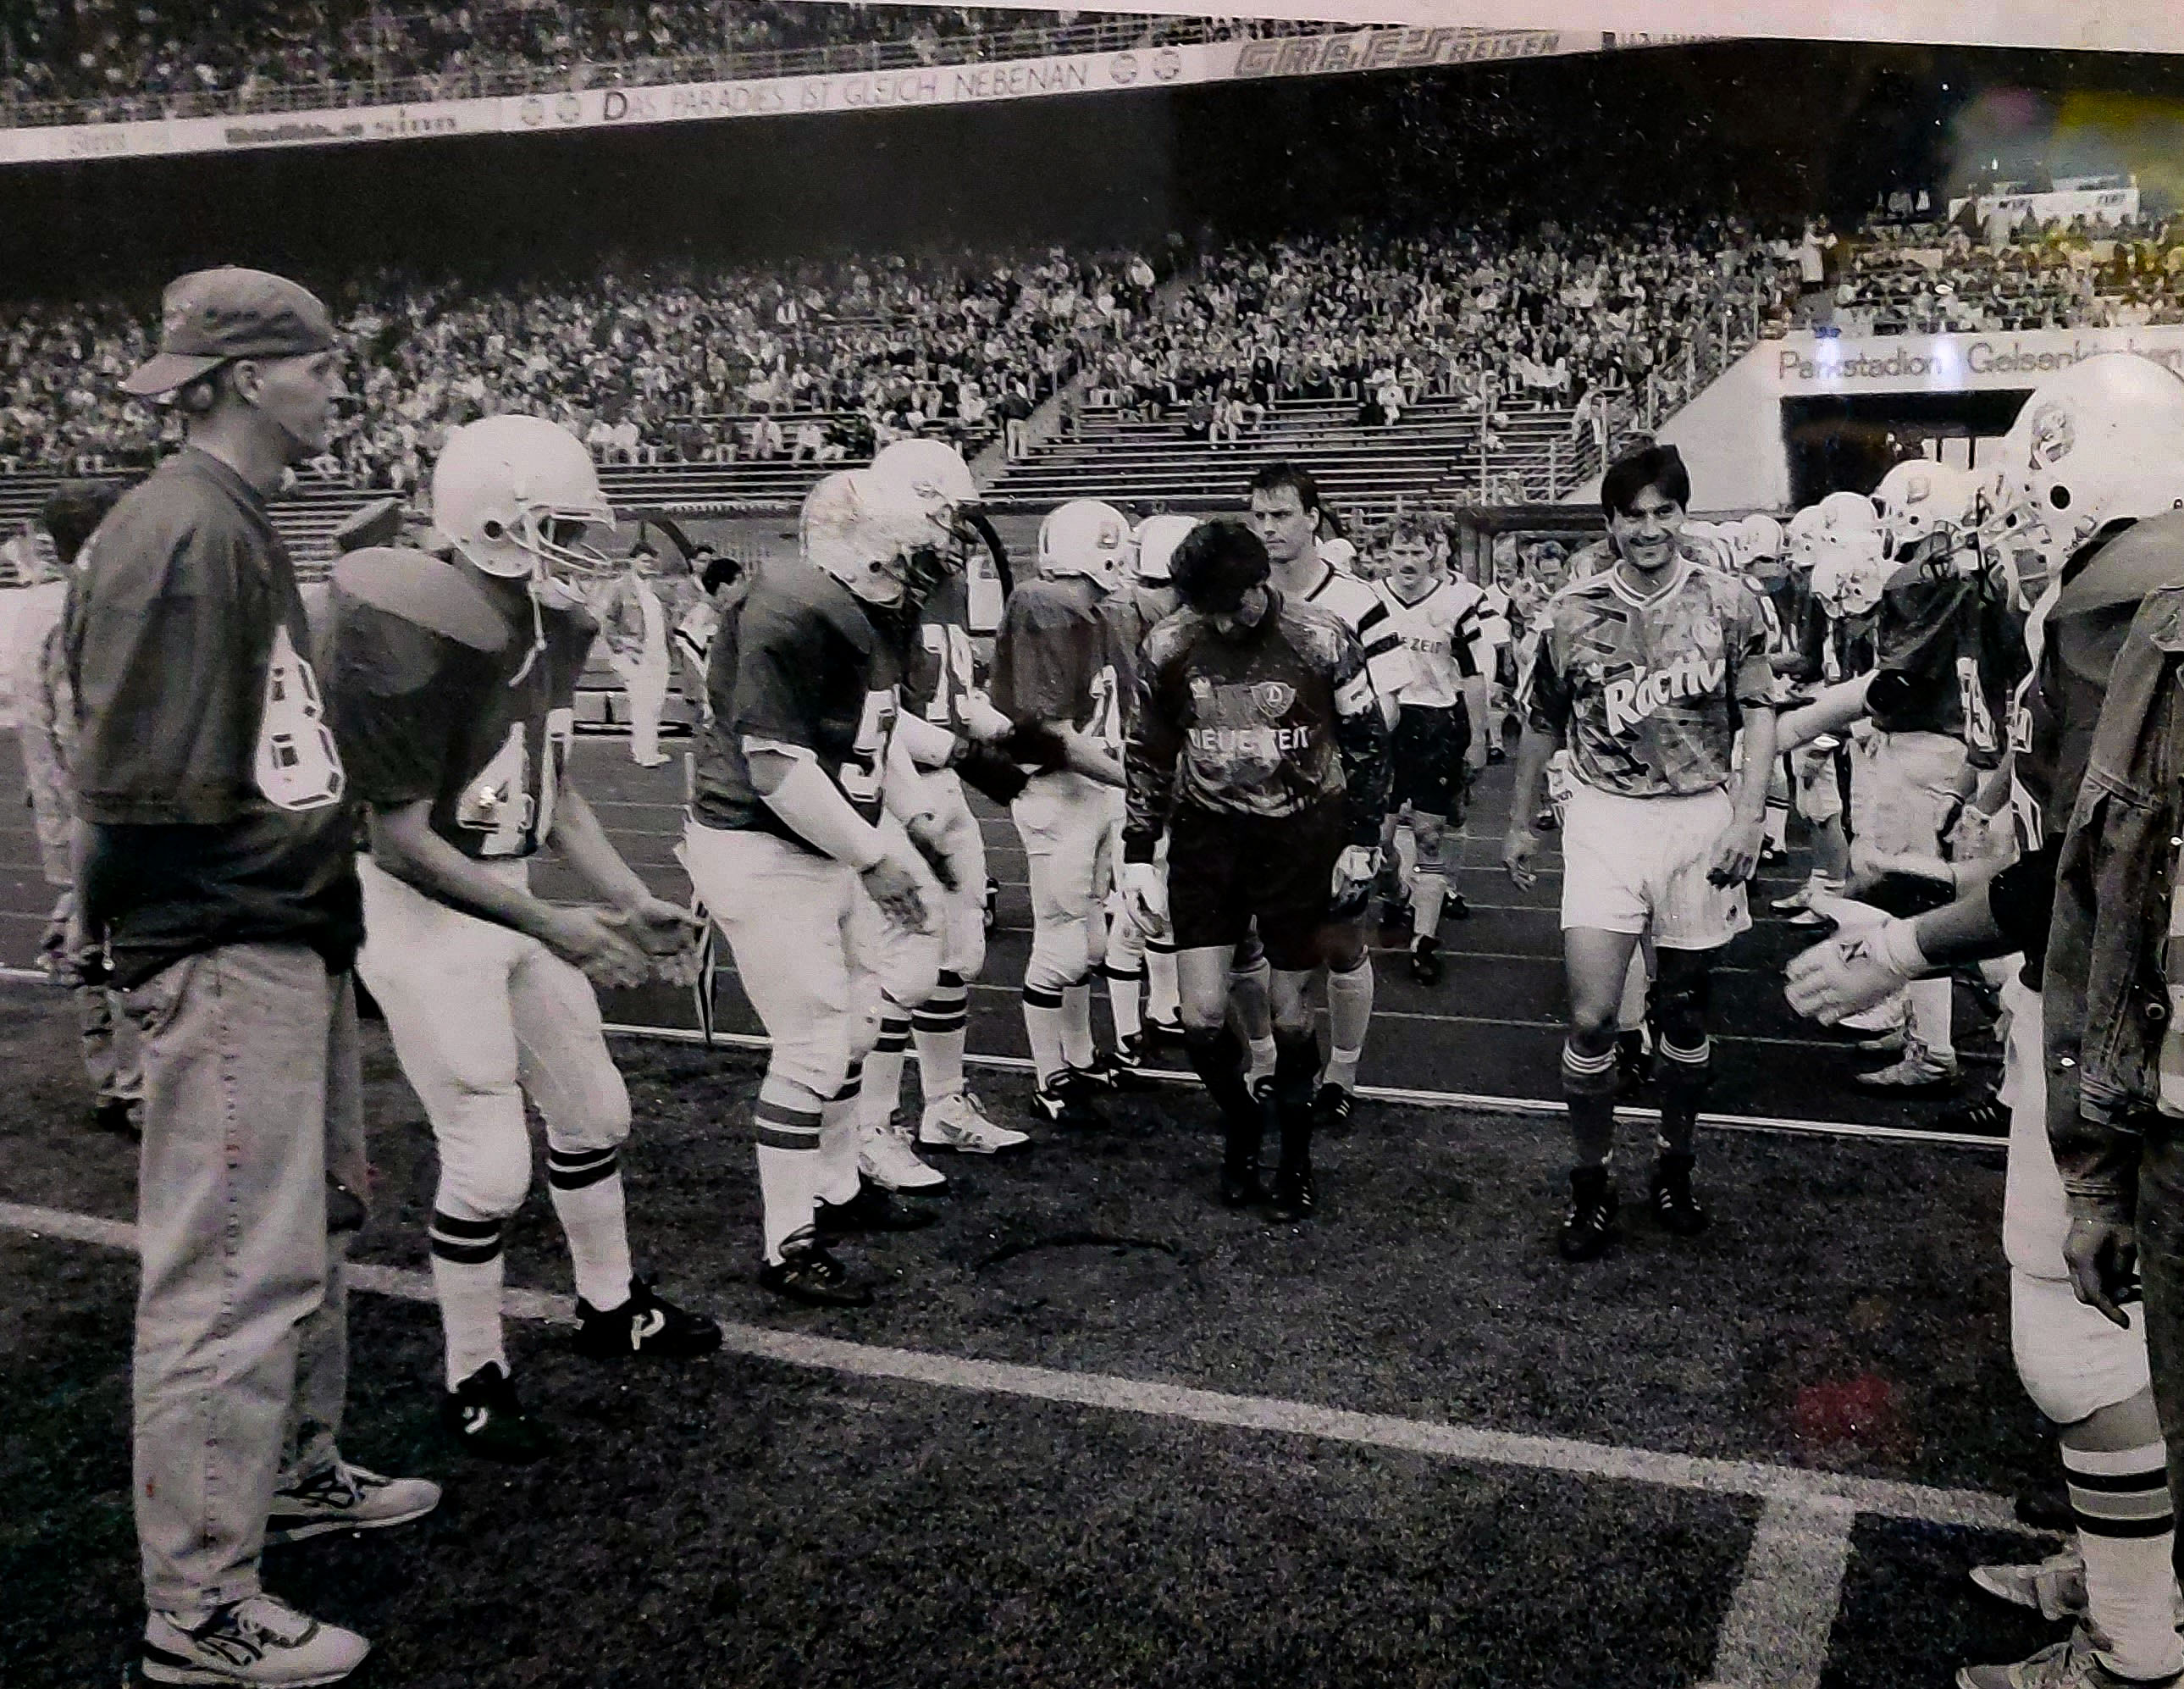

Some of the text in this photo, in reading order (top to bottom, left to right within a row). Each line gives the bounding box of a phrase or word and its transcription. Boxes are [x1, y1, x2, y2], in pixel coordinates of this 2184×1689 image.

[843, 74, 937, 104] GLEICH
[956, 62, 1088, 99] NEBENAN
[1779, 346, 1943, 380] Pastadion
